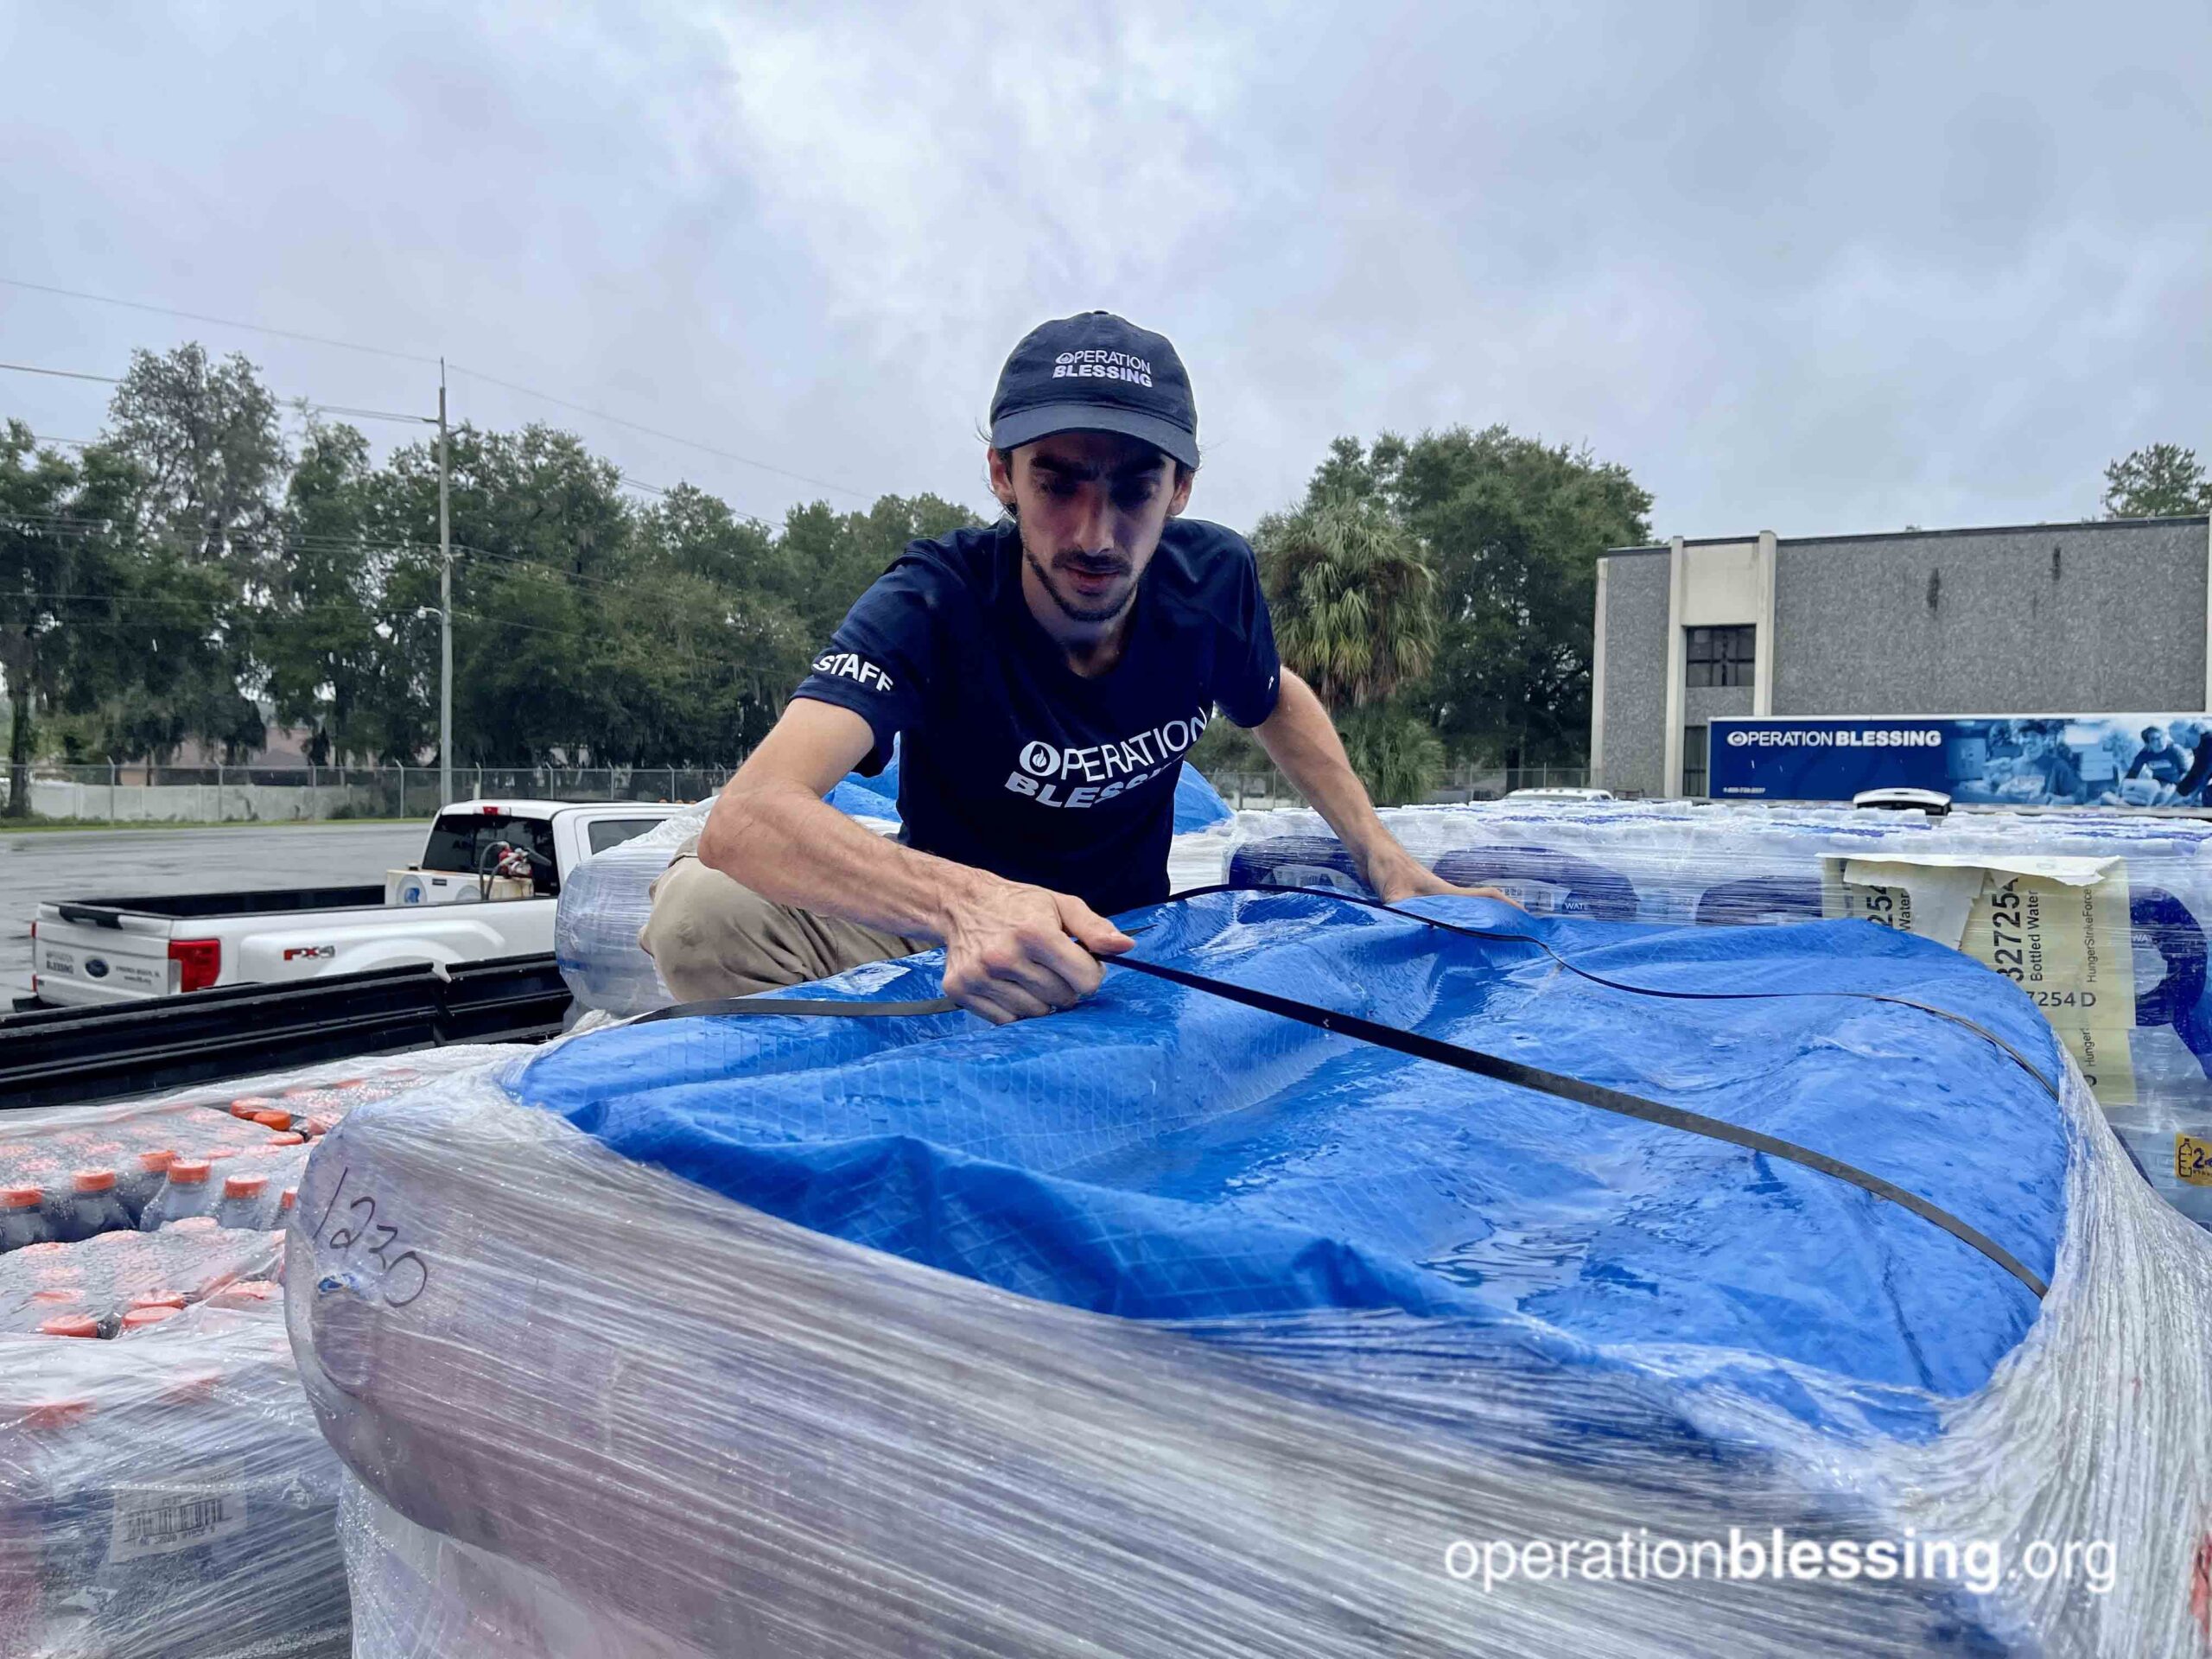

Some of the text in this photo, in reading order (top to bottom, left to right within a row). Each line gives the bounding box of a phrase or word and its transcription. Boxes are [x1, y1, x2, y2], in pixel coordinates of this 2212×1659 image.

[1052, 364, 1153, 388] BLESSING
[1055, 350, 1151, 375] OPERATION
[812, 653, 893, 691] STAFF
[1020, 707, 1207, 782] OPERATION
[1727, 730, 1942, 747] OPERATION BLESSING
[1005, 754, 1184, 808] BLESS
[1898, 893, 1911, 931] Water
[2027, 890, 2043, 982] Bottled Water
[312, 1166, 429, 1308] 1230
